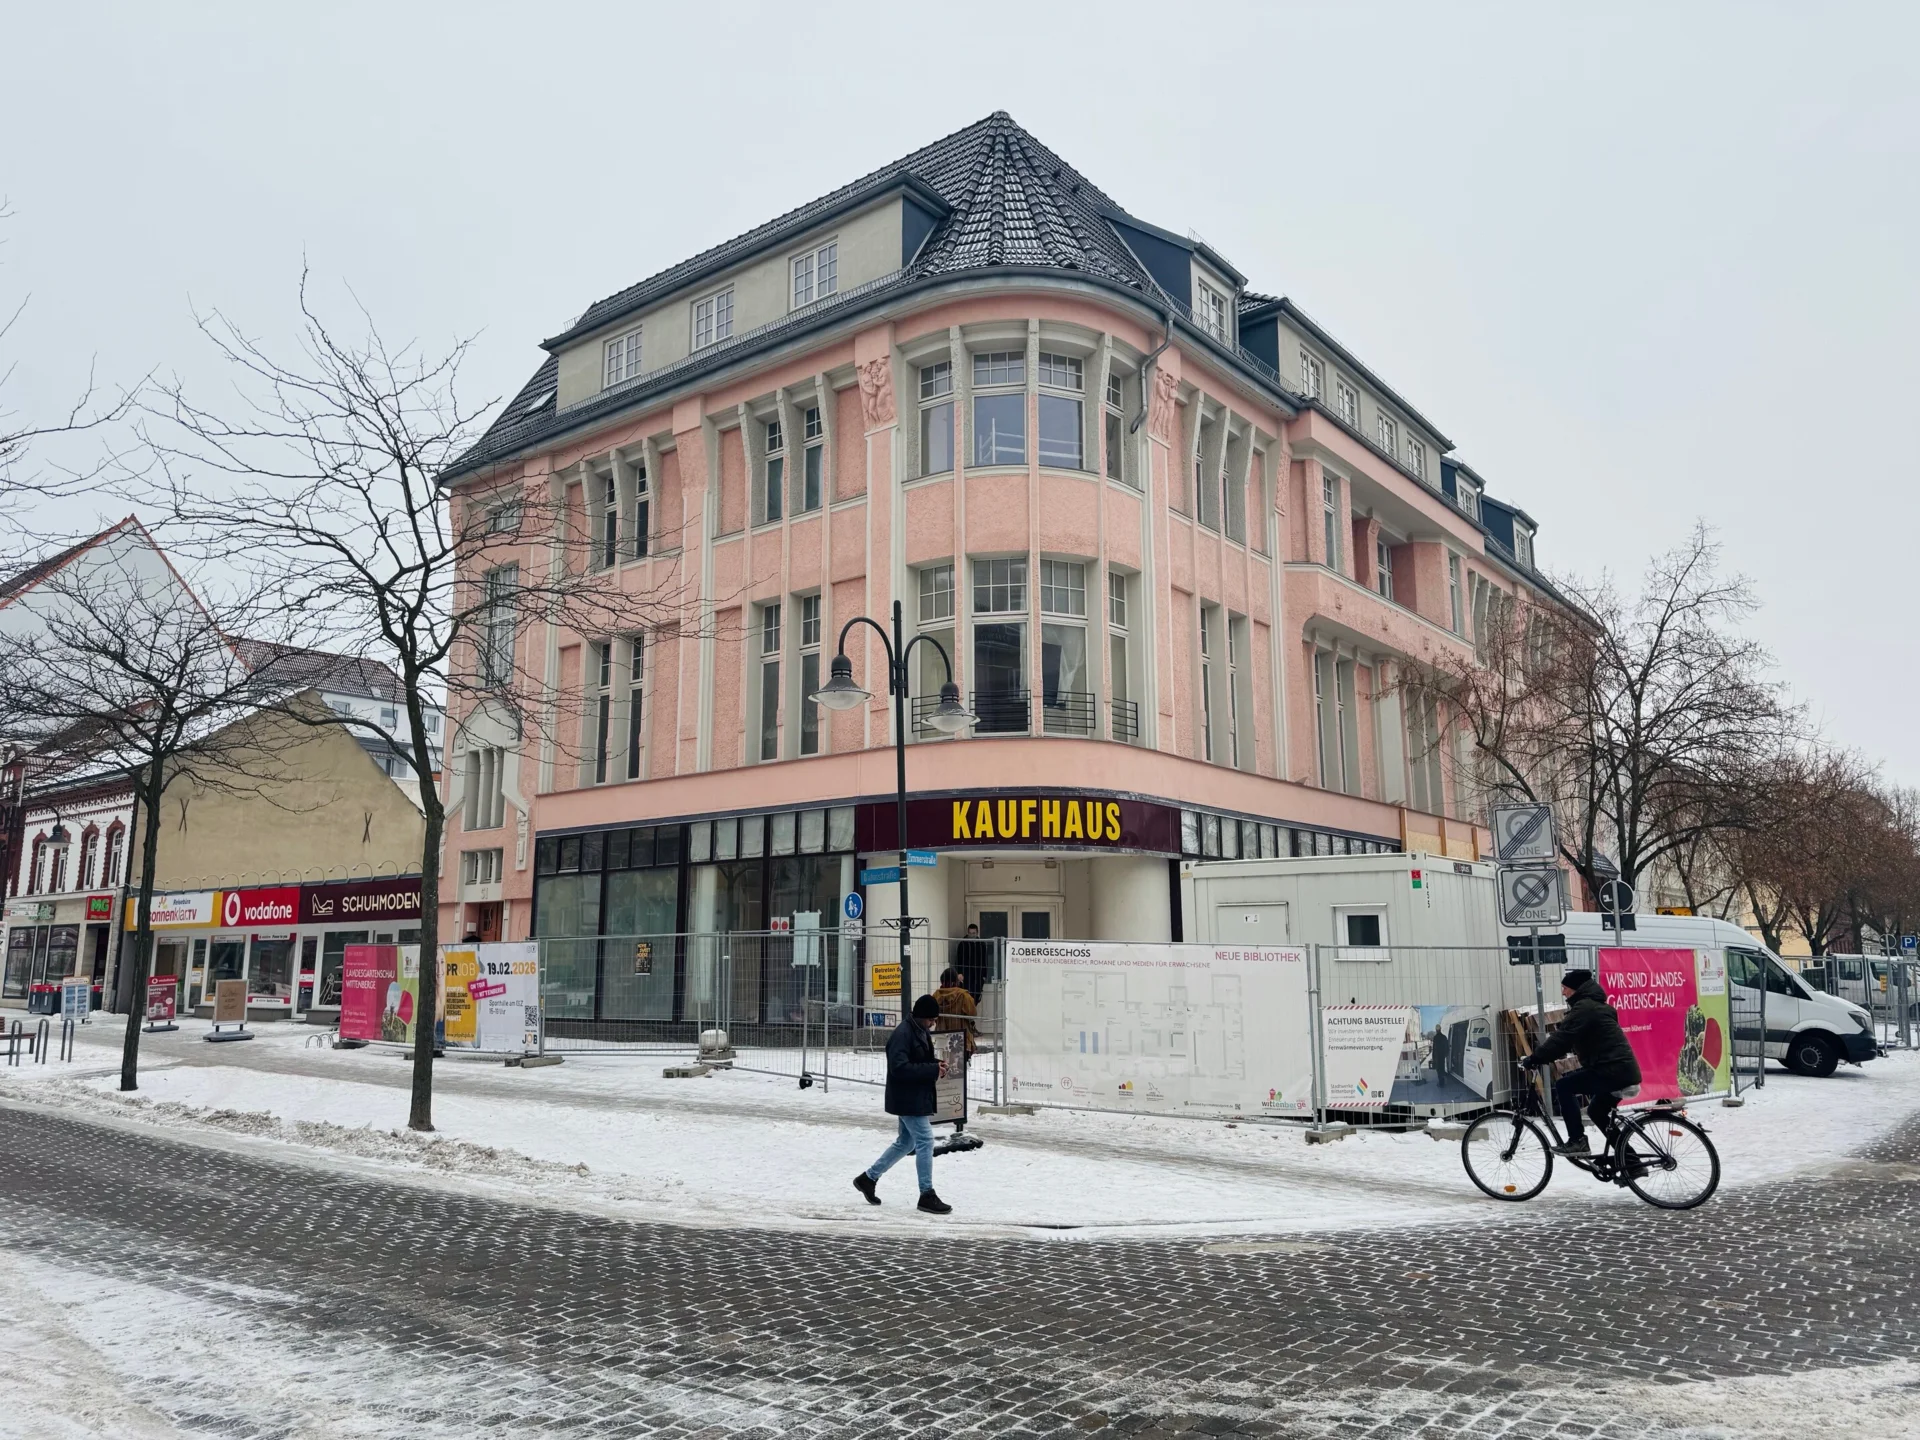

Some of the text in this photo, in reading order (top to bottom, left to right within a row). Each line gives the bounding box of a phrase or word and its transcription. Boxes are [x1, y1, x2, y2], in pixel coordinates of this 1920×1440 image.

[953, 800, 1121, 841] KAUFHAUS
[908, 853, 936, 864] Zimmerstraße
[90, 898, 110, 912] MG
[342, 892, 421, 913] SCHUHMODEN
[244, 900, 292, 920] vodafone
[1520, 910, 1547, 919] ZONE
[1904, 938, 1912, 946] P
[1011, 948, 1091, 958] 2.OBERGESCHOSS
[1215, 951, 1301, 962] NEUE BIBLIOTHEK
[346, 969, 395, 978] LANDESGARTENSCHAU
[487, 961, 536, 976] 19.02.2026
[346, 980, 376, 990] WITTENBERGE
[1606, 971, 1686, 988] WIR SIND LANDES-
[1606, 992, 1675, 1010] GARTENSCHAU
[1019, 1080, 1053, 1089] Wittenberge
